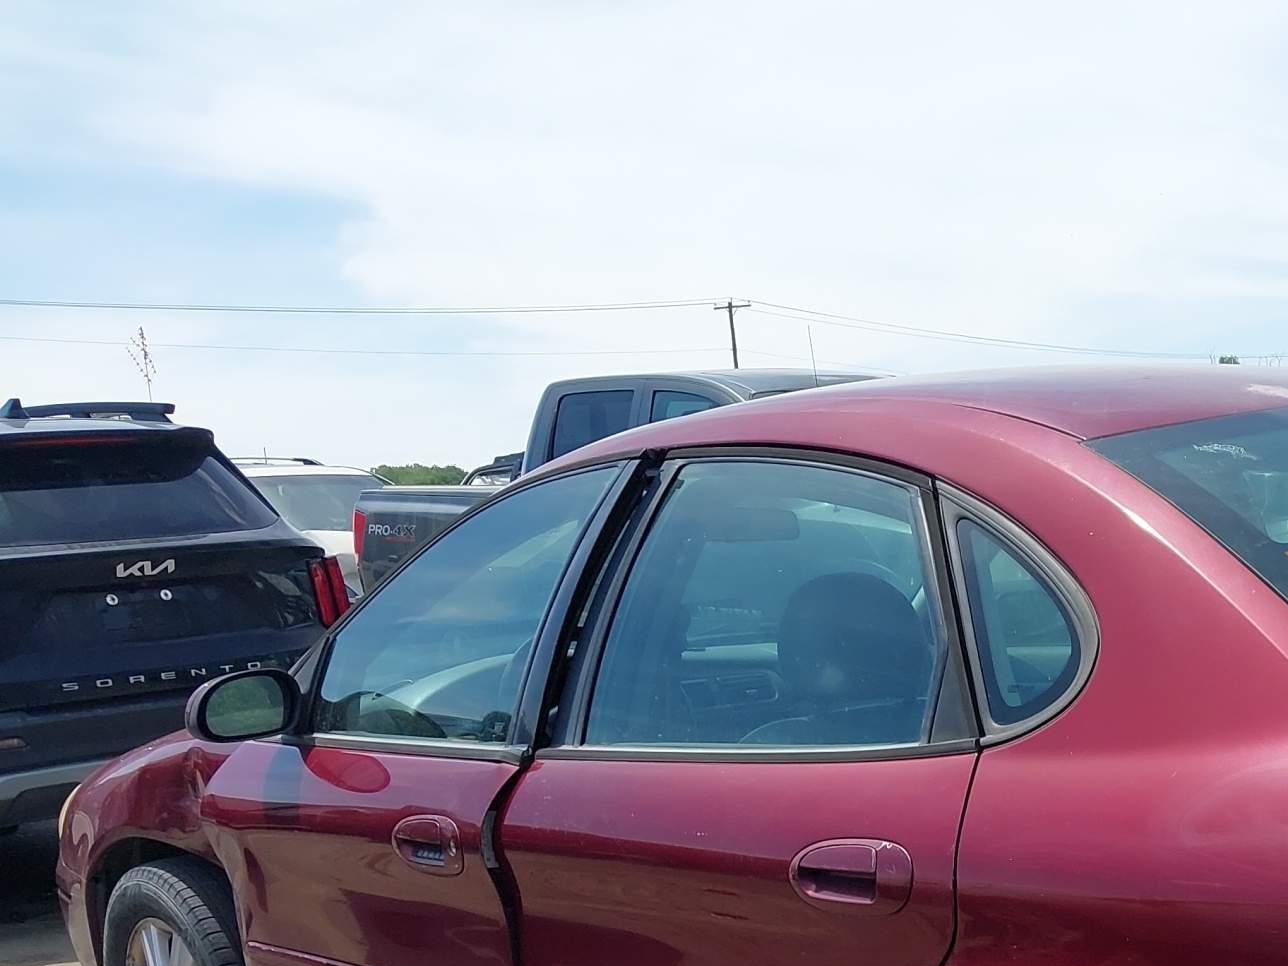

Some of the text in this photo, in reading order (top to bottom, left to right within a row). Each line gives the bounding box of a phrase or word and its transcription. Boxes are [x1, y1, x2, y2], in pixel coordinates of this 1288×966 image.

[368, 524, 416, 537] PRO-4X
[116, 558, 176, 578] KIA
[61, 661, 262, 692] SORENTO
